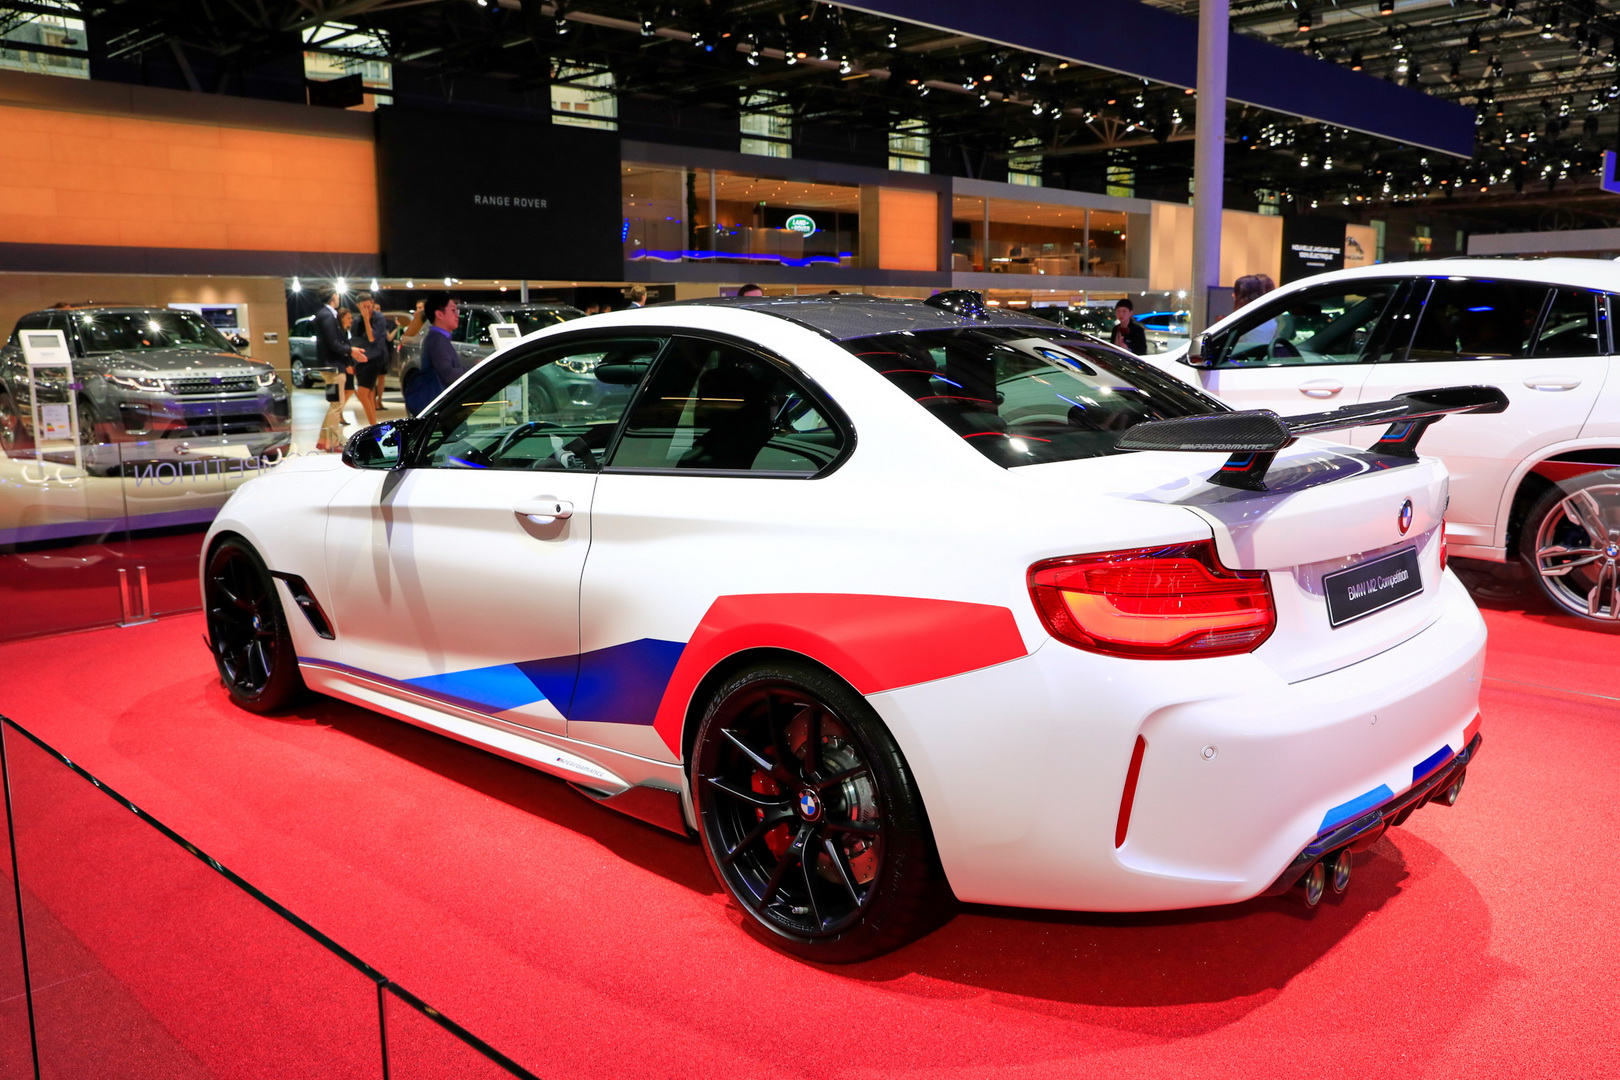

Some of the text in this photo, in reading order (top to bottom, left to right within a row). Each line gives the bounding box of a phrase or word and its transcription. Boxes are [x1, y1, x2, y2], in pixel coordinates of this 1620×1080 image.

[474, 194, 547, 208] RANGE ROVER
[1347, 568, 1409, 601] BMW M2 Competition
